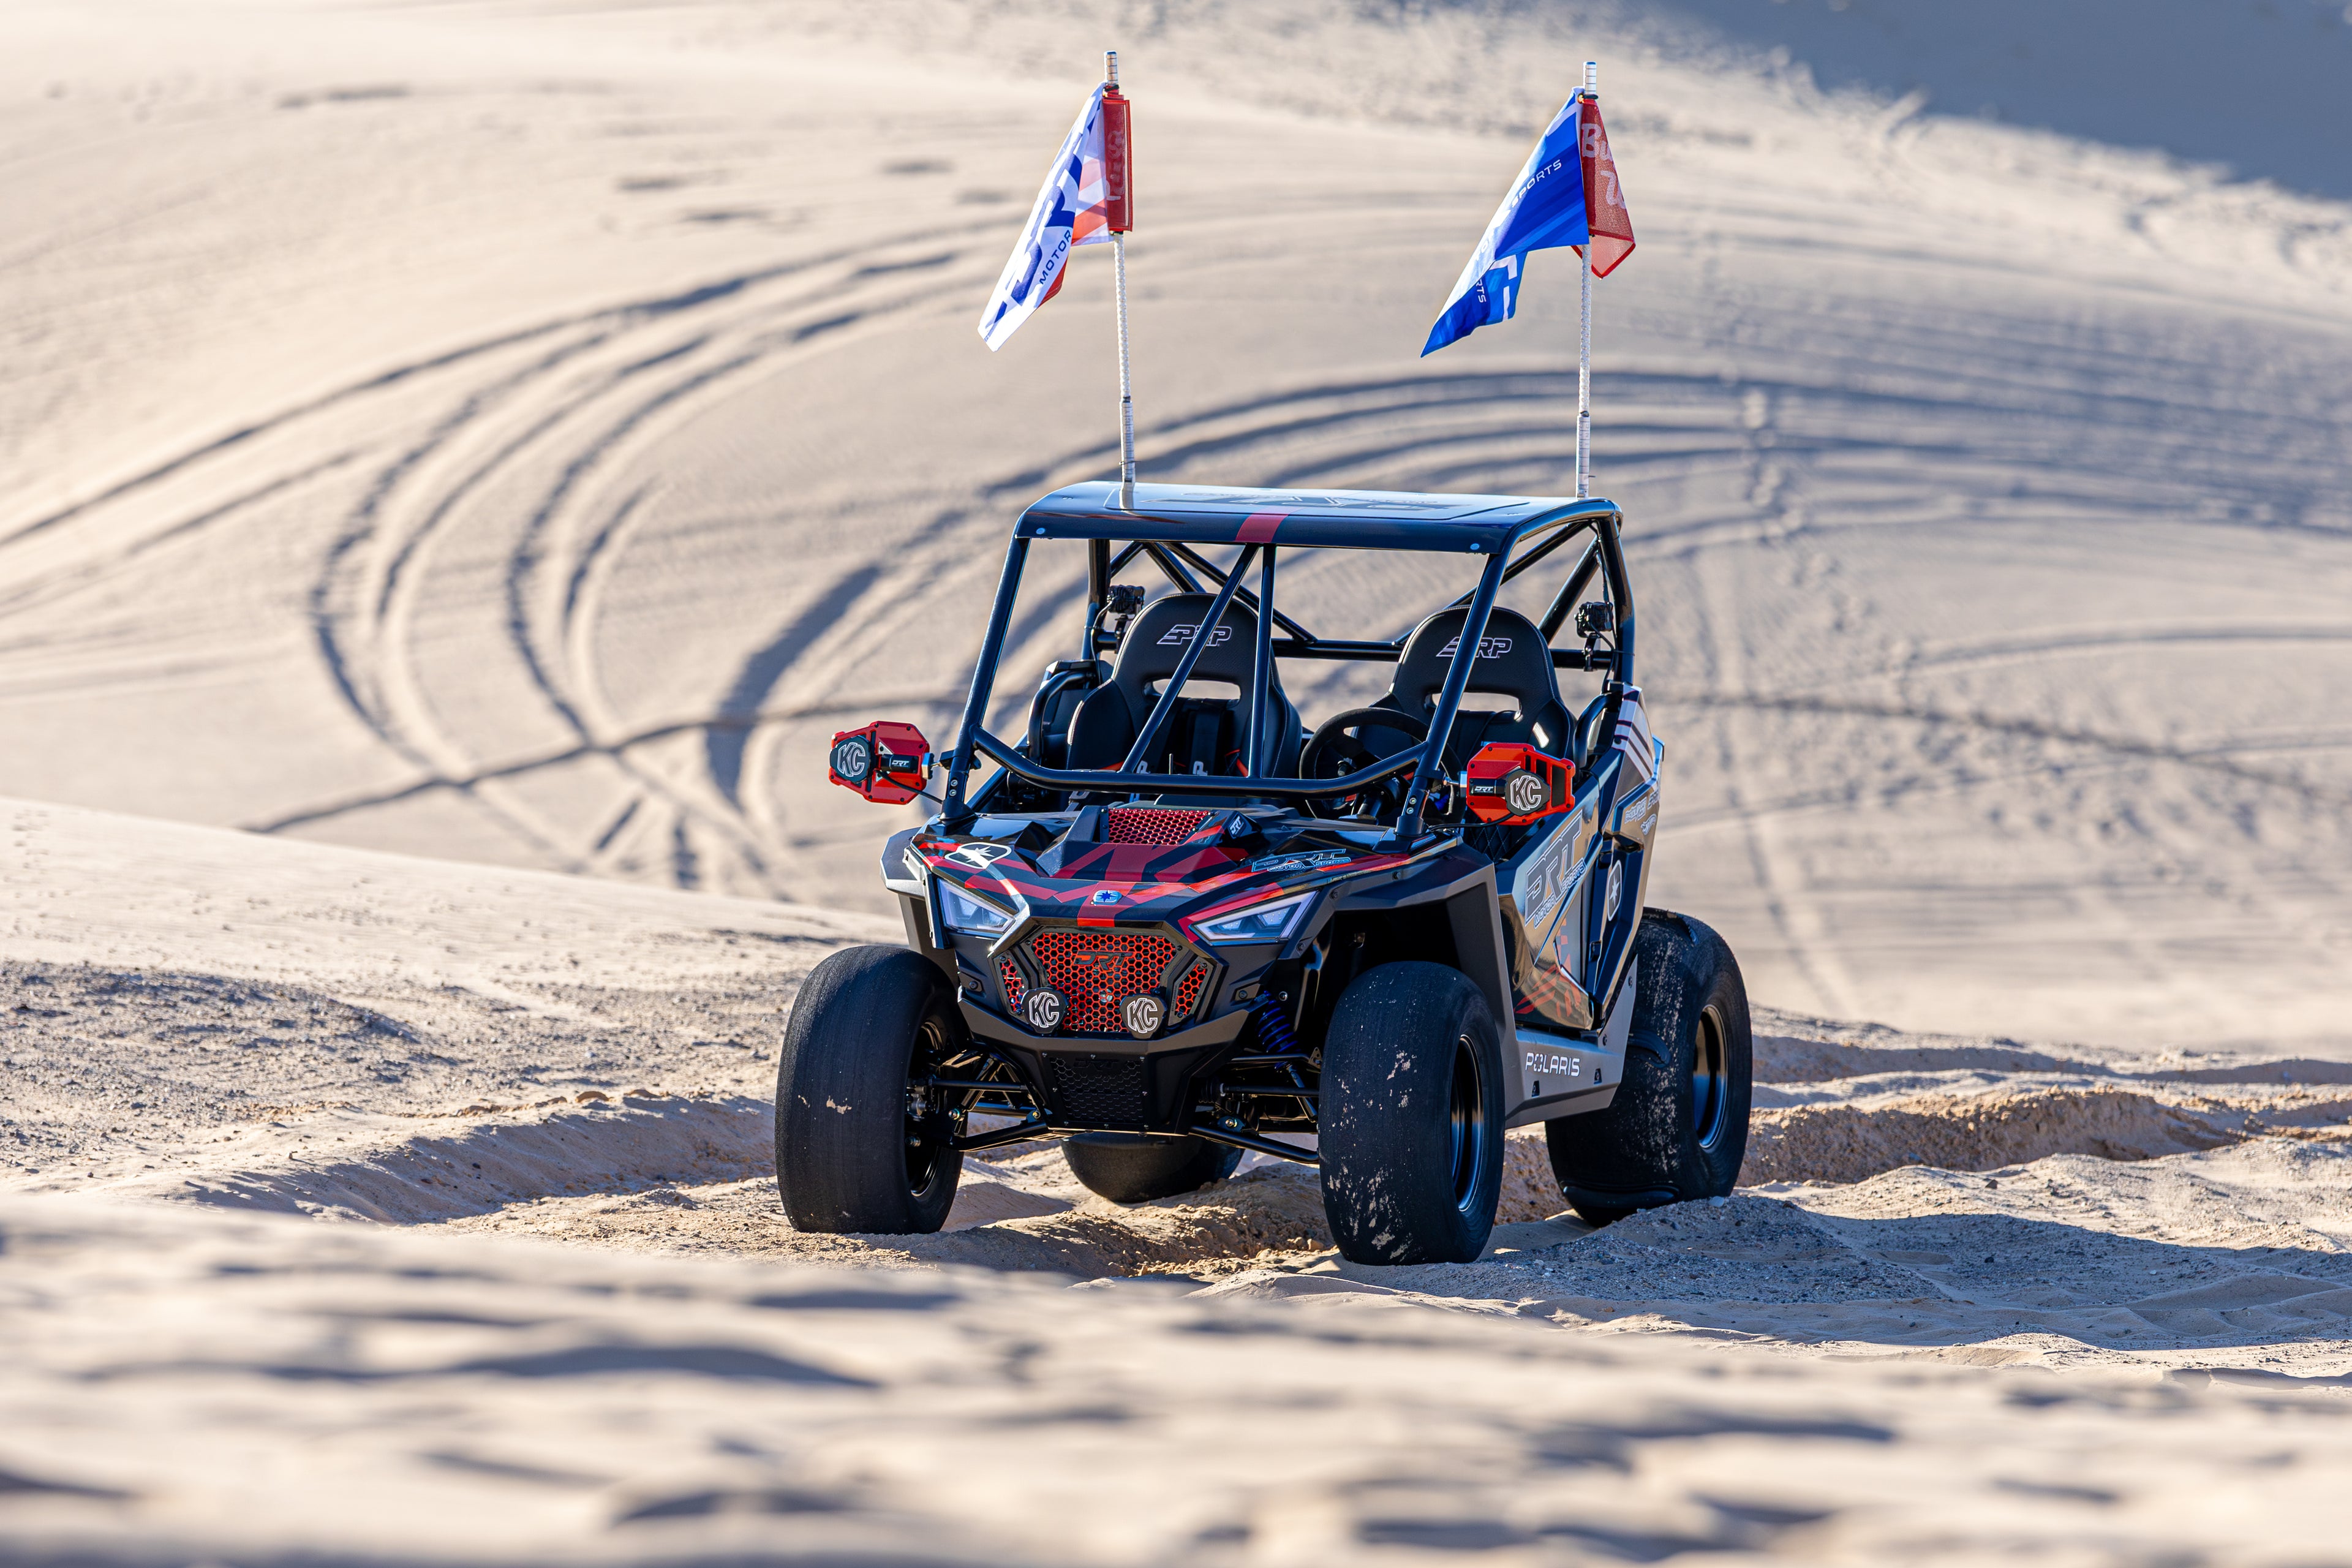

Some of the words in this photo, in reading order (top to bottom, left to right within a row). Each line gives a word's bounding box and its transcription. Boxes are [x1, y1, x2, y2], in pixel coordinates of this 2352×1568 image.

[1512, 159, 1562, 208] SPORTS
[1039, 230, 1071, 285] MOTOR
[837, 742, 866, 777] KC
[1510, 775, 1542, 811] KC
[1525, 809, 1583, 927] DRT
[1029, 992, 1060, 1028] KC
[1126, 998, 1158, 1033] KC
[1525, 1052, 1580, 1076] POLARIS
